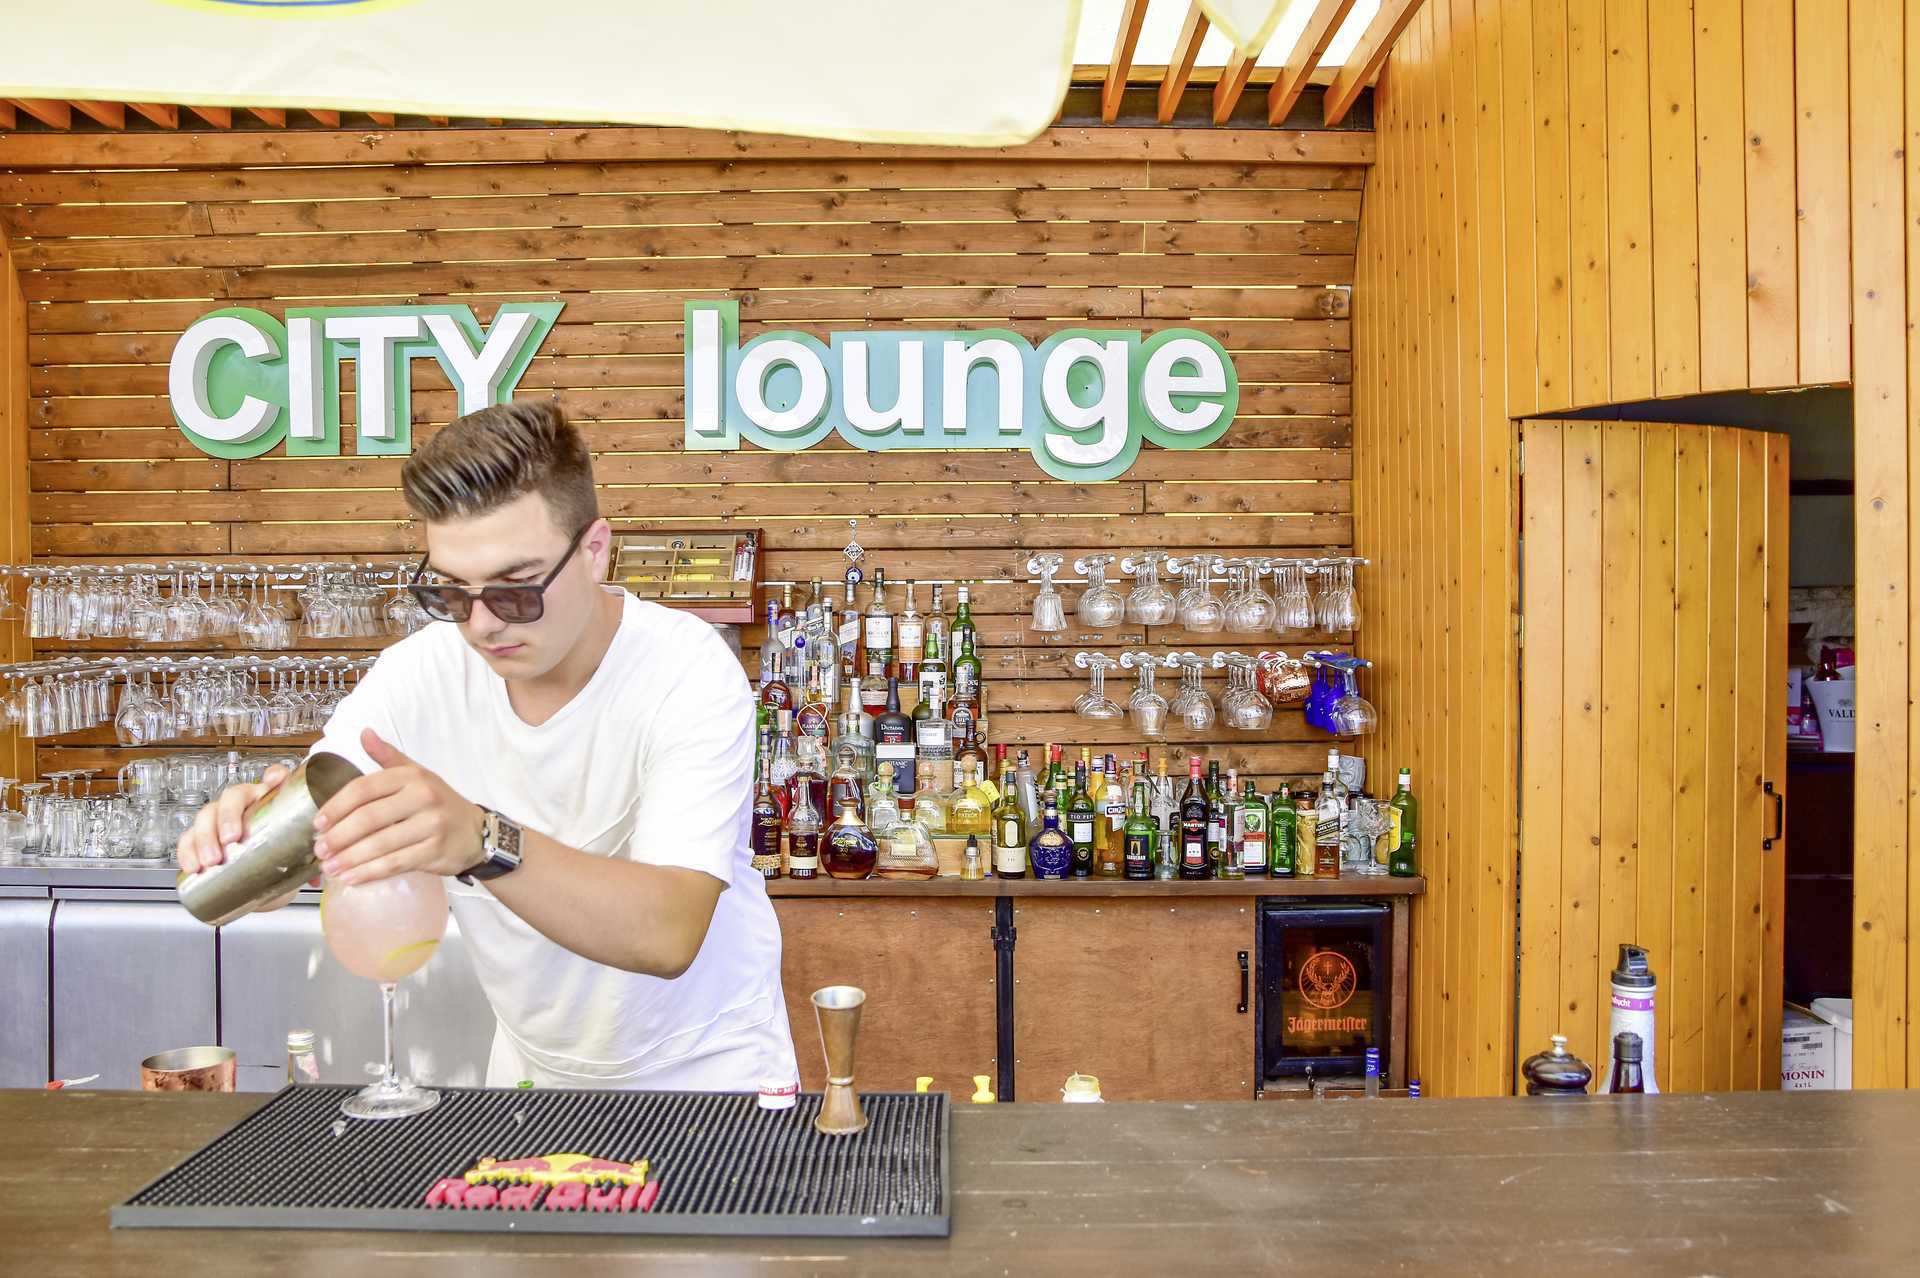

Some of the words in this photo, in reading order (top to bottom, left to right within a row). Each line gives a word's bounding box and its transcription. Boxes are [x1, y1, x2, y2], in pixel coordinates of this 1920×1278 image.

[169, 312, 541, 445] CITY
[692, 309, 1228, 467] lounge
[1780, 1070, 1825, 1081] MONIN
